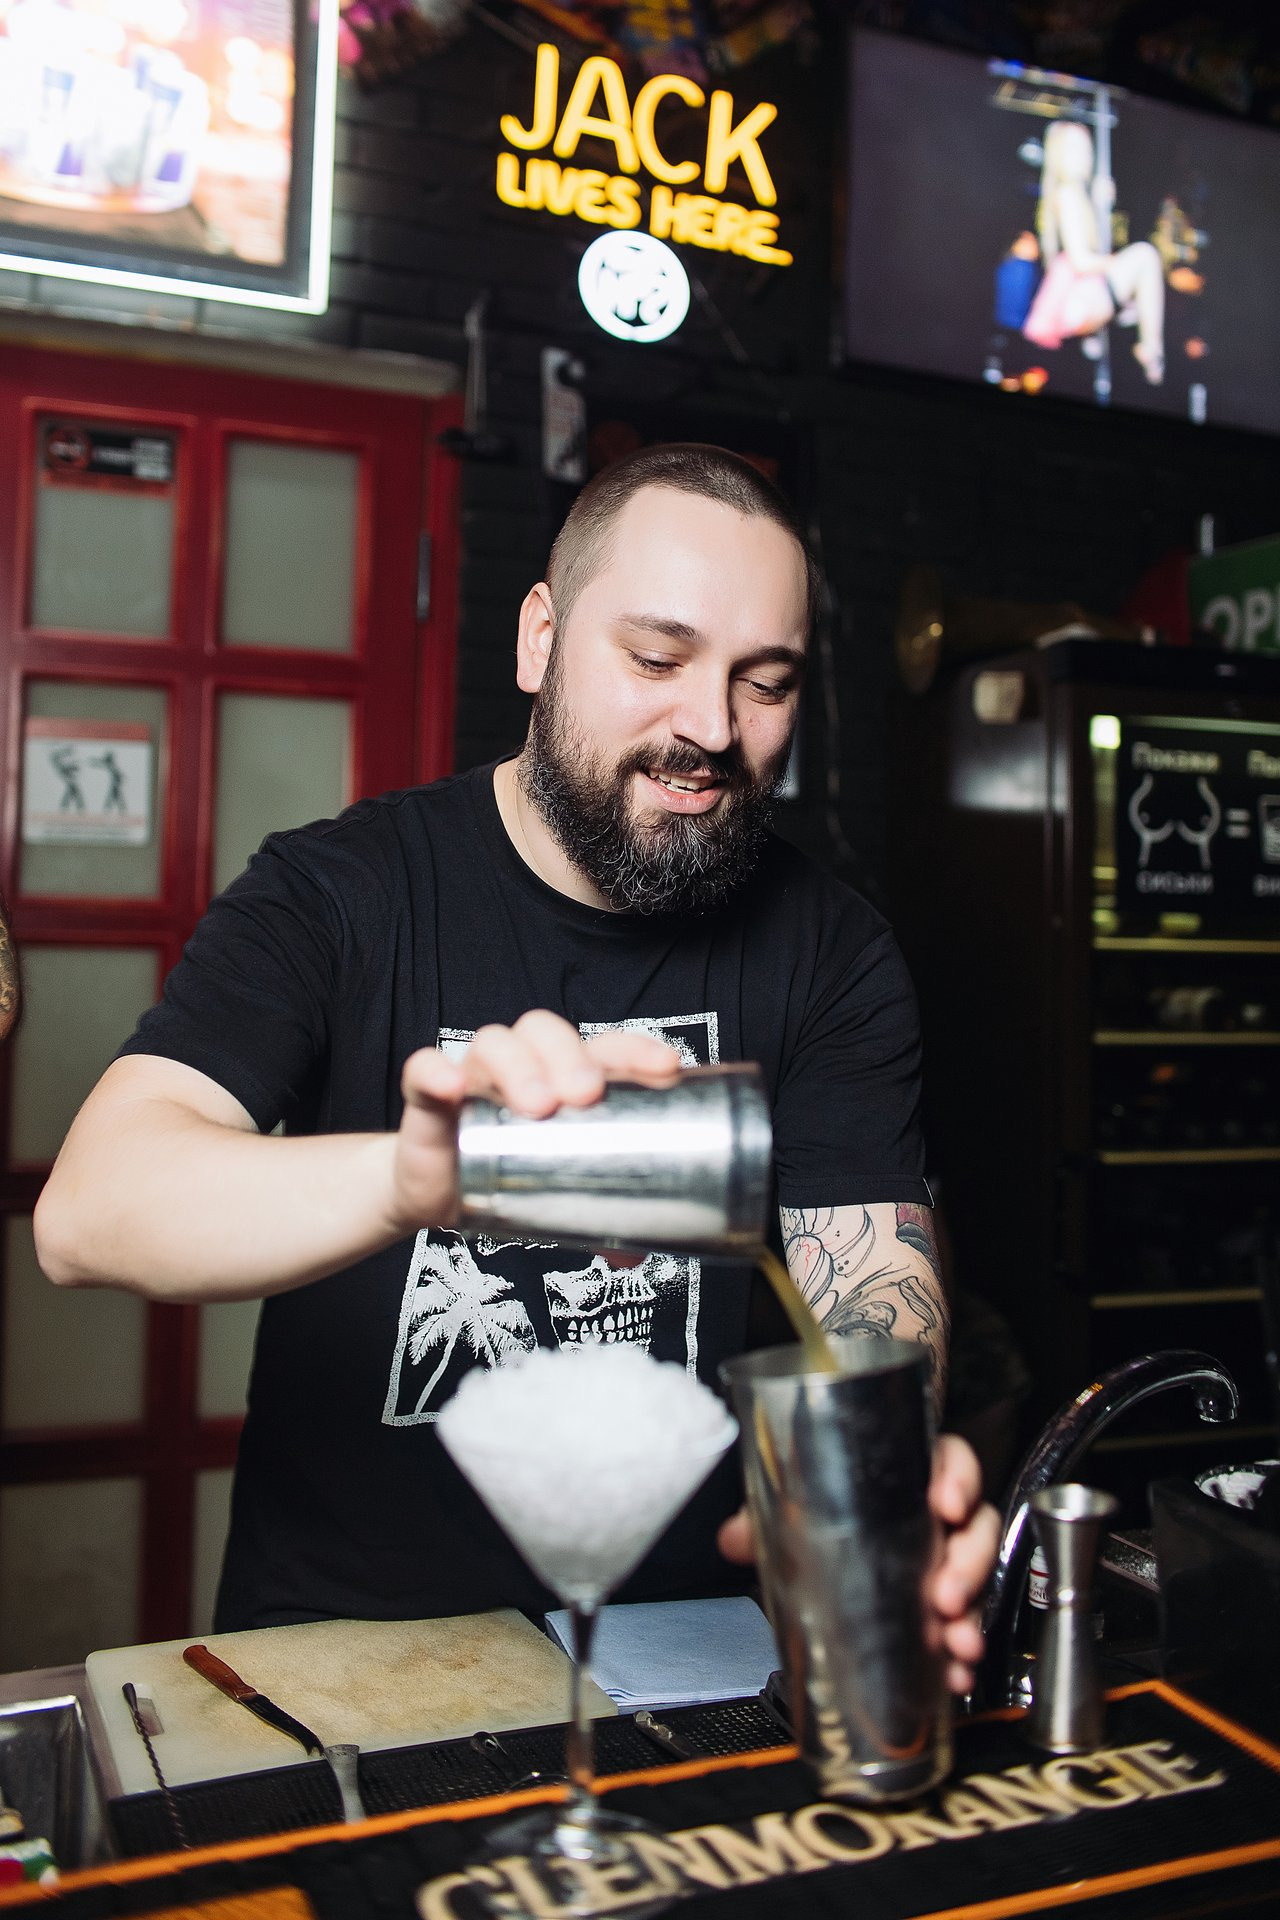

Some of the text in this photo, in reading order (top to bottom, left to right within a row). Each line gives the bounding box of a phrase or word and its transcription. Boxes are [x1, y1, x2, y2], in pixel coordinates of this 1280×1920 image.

[500, 43, 778, 207] JACK
[496, 152, 794, 267] LIVES HERE
[1201, 586, 1280, 652] OP
